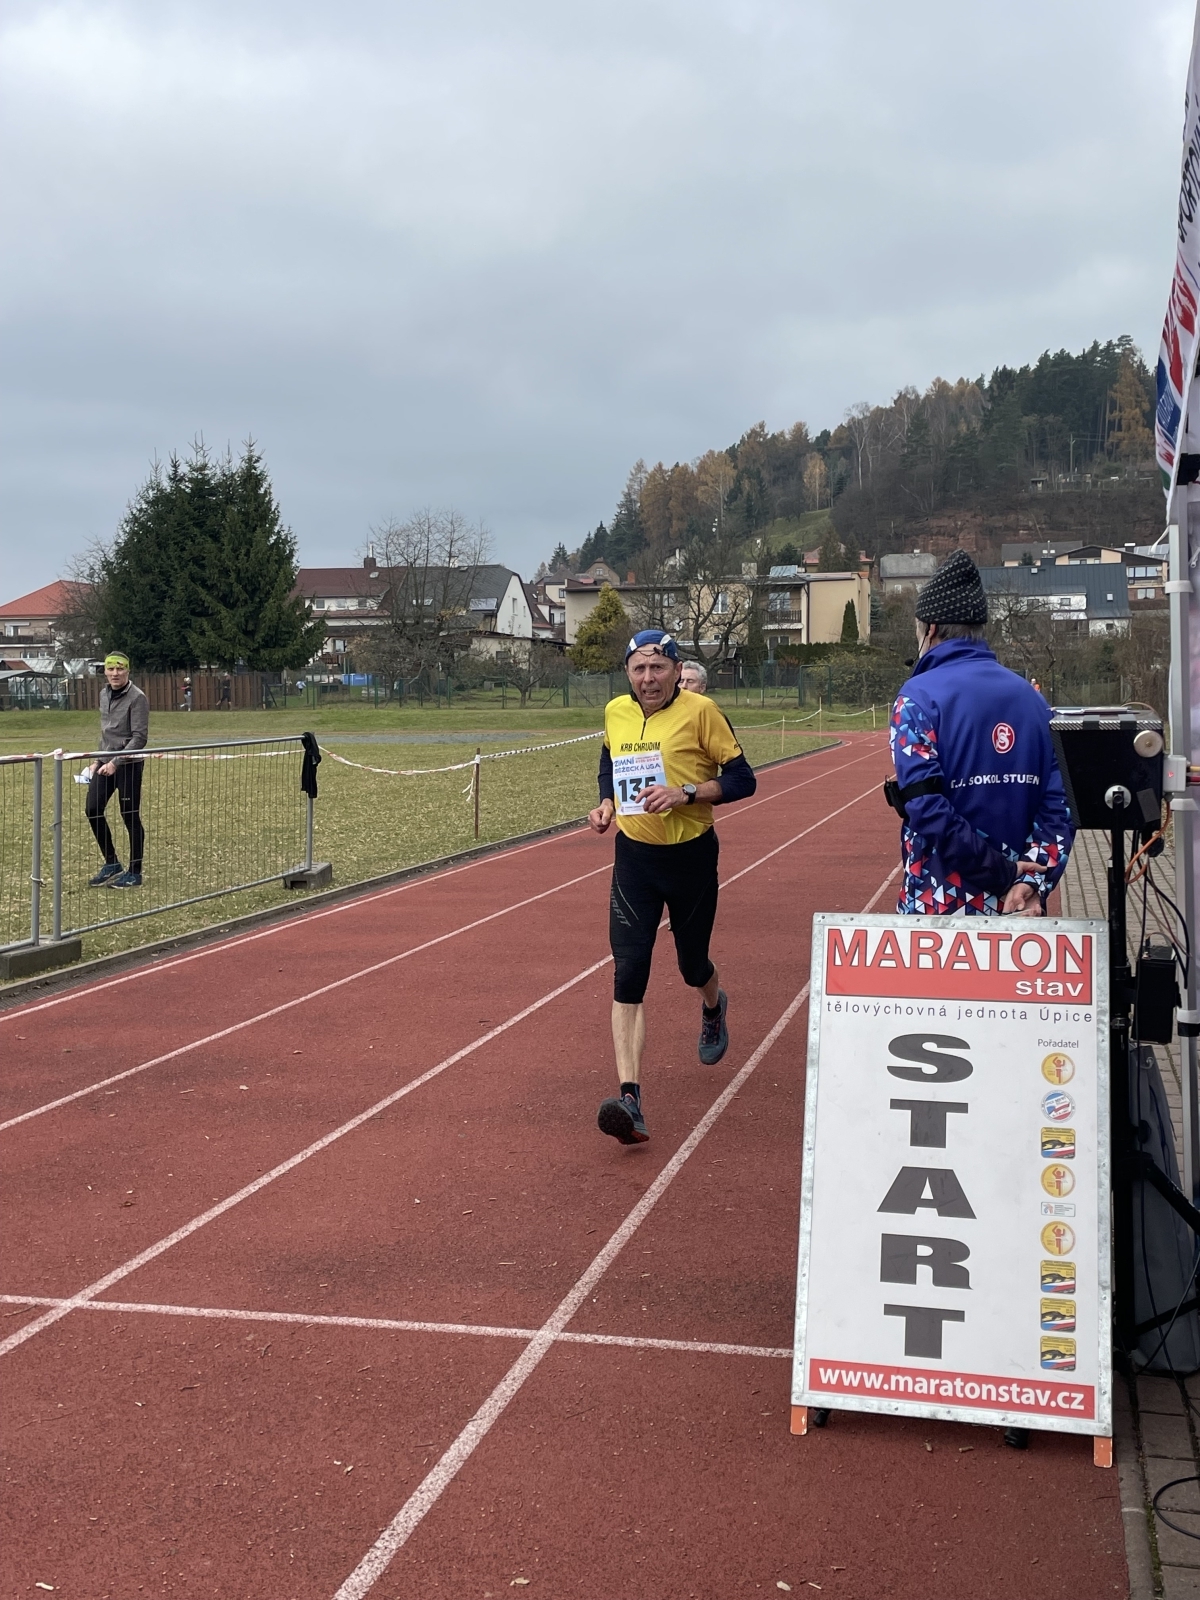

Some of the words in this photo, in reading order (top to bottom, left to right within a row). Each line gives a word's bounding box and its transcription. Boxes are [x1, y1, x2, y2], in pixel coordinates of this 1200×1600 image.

[968, 774, 1001, 786] SOKOL
[827, 928, 1093, 975] MARATON
[1015, 978, 1085, 998] stav
[826, 1001, 948, 1018] tělovýchovná
[956, 1006, 1028, 1021] jednota
[1039, 1006, 1093, 1023] Úpice
[1037, 1038, 1080, 1049] Pořadatel
[875, 1032, 978, 1360] START
[818, 1366, 1085, 1411] www.maratonstav.cz
